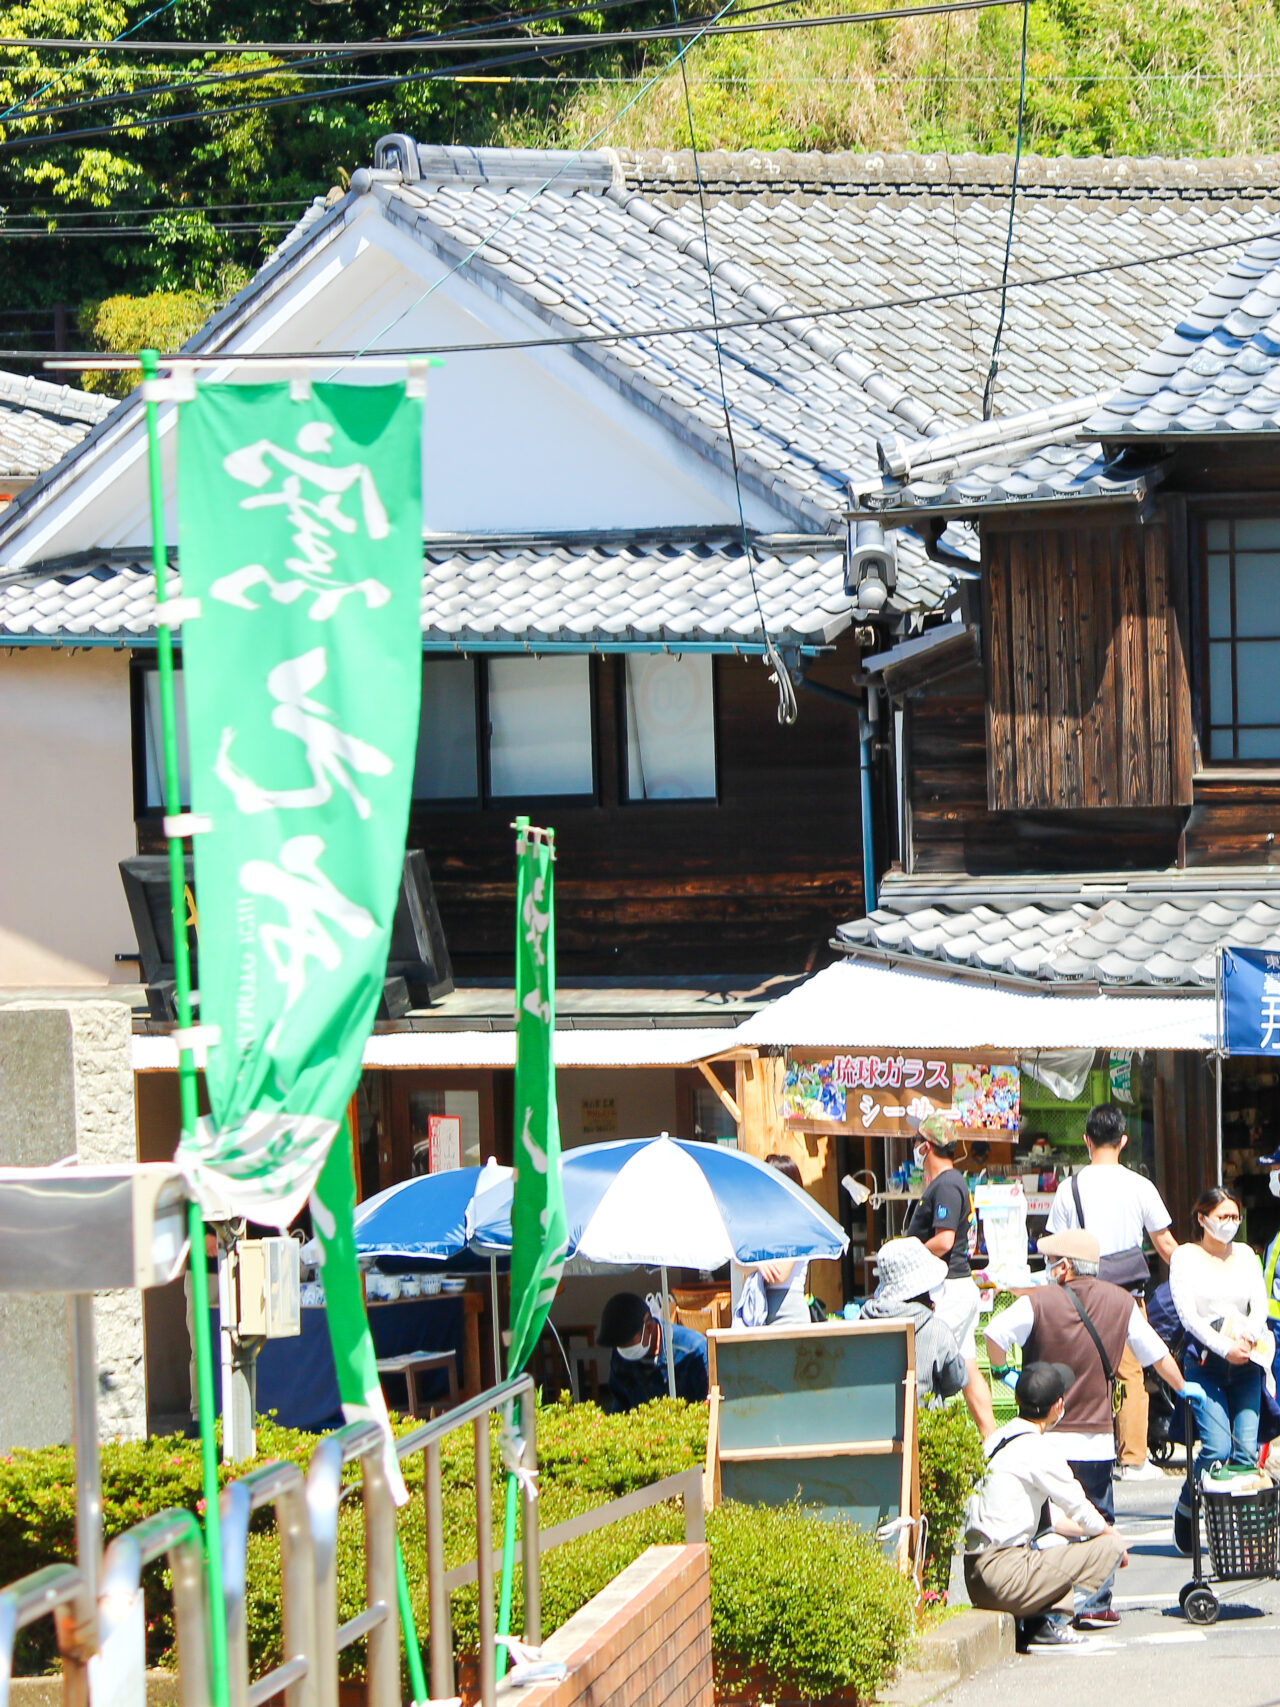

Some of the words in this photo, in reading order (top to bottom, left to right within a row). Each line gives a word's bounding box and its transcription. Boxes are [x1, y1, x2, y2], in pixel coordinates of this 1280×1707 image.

[834, 1055, 950, 1089] 琉球ガラス
[859, 1094, 962, 1128] シーサー
